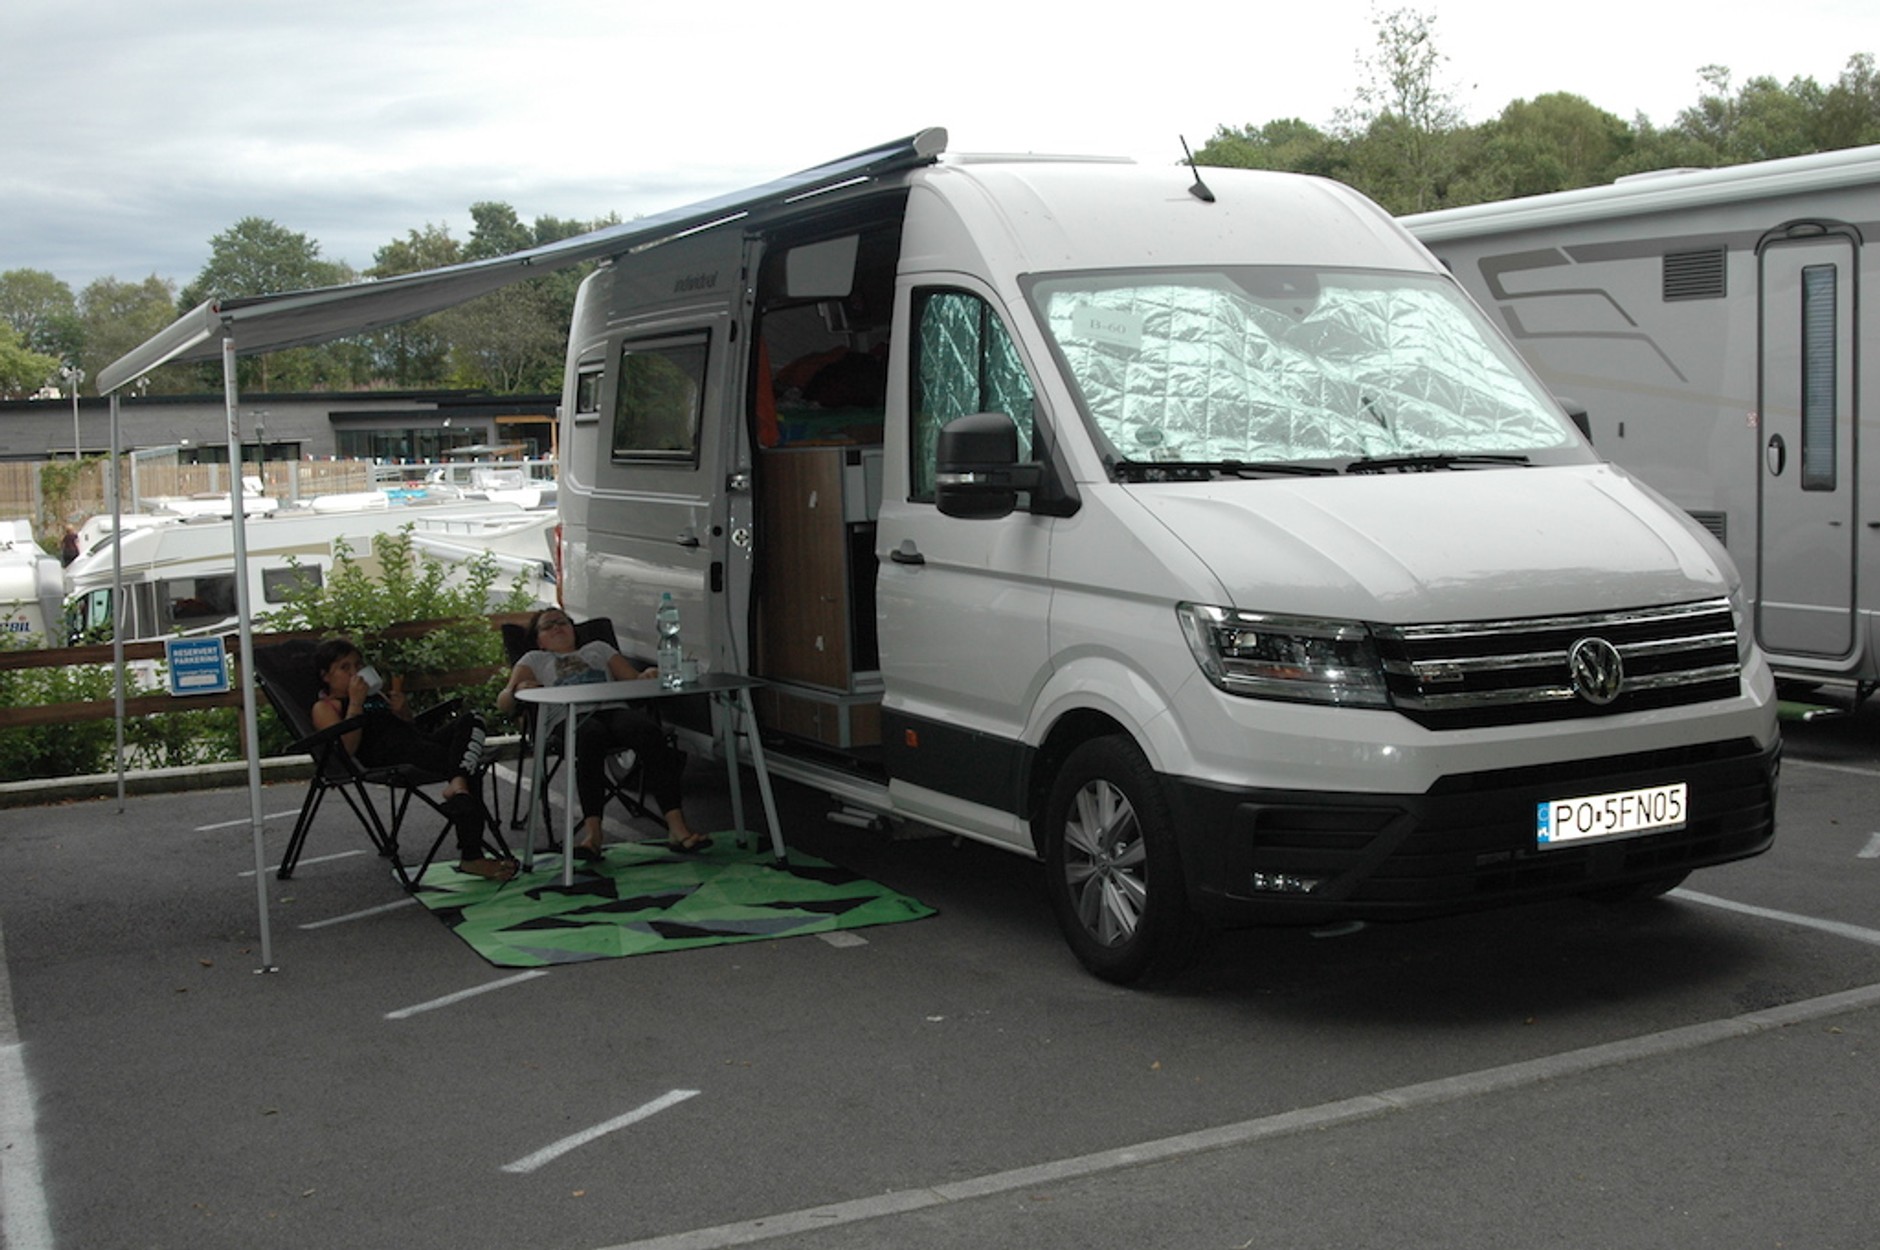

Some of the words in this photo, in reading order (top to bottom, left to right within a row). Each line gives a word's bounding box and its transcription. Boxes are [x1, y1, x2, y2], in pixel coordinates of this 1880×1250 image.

[1090, 319, 1127, 335] B-60
[173, 647, 218, 657] RESERVERT
[174, 655, 220, 666] PARKERING
